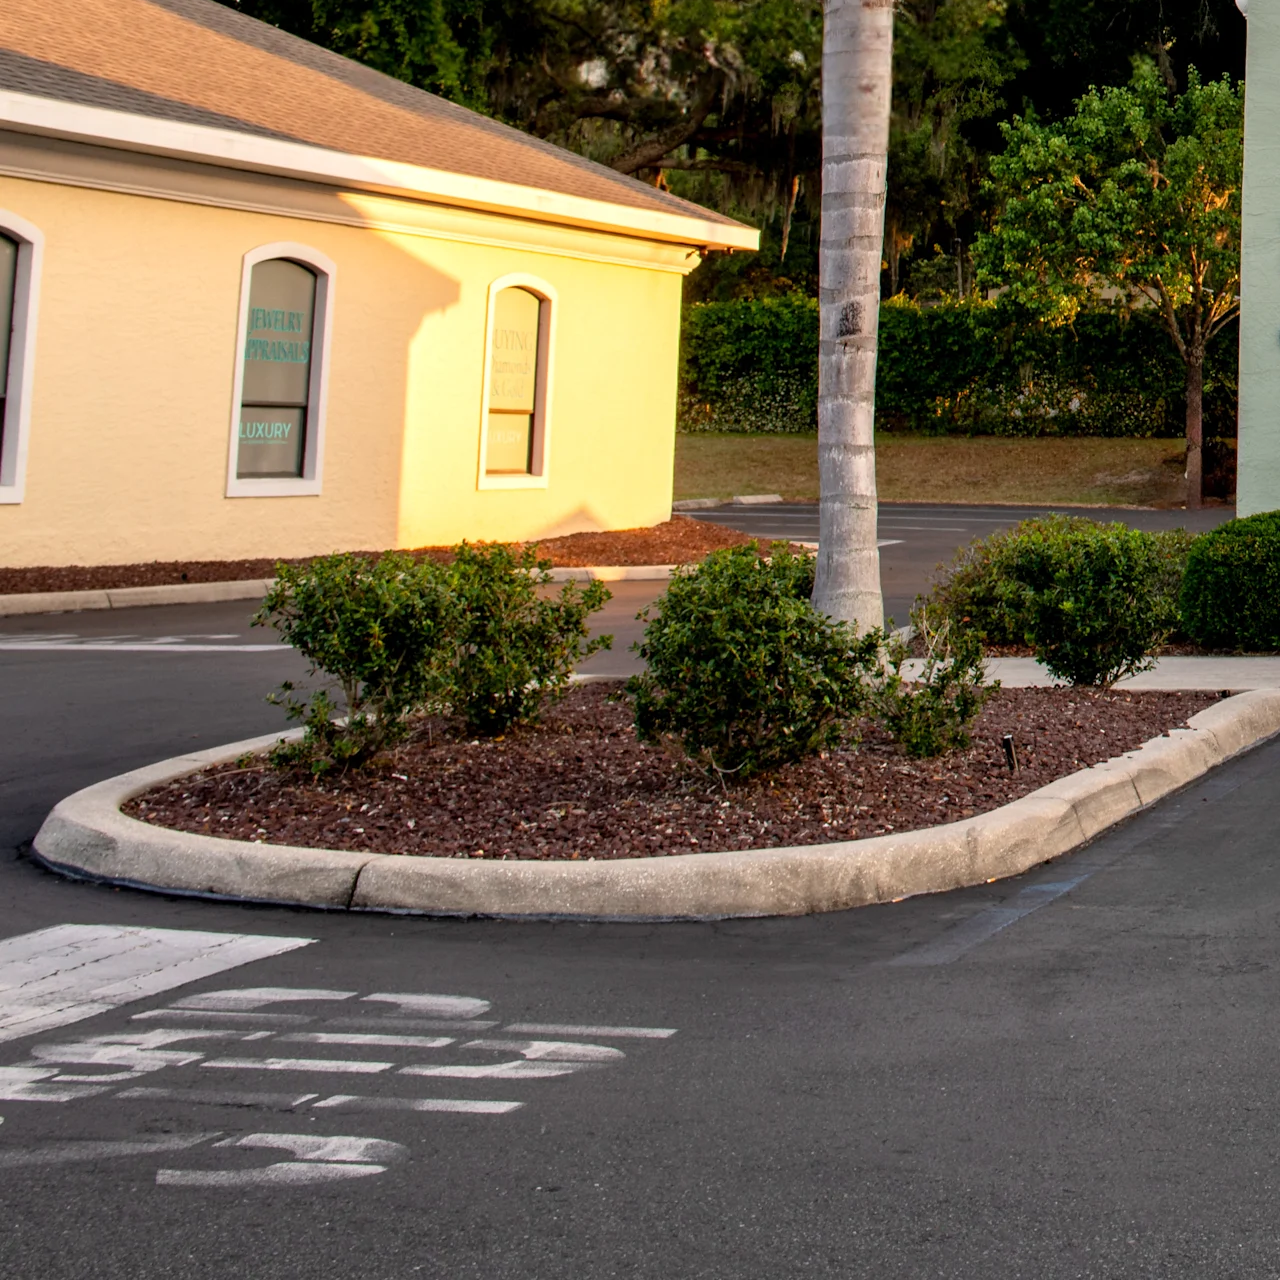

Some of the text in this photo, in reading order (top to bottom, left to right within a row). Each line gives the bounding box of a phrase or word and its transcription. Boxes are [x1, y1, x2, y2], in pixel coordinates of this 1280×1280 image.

[248, 307, 305, 334] JEWELRY
[492, 329, 533, 351] UYING
[238, 422, 292, 438] LUXURY
